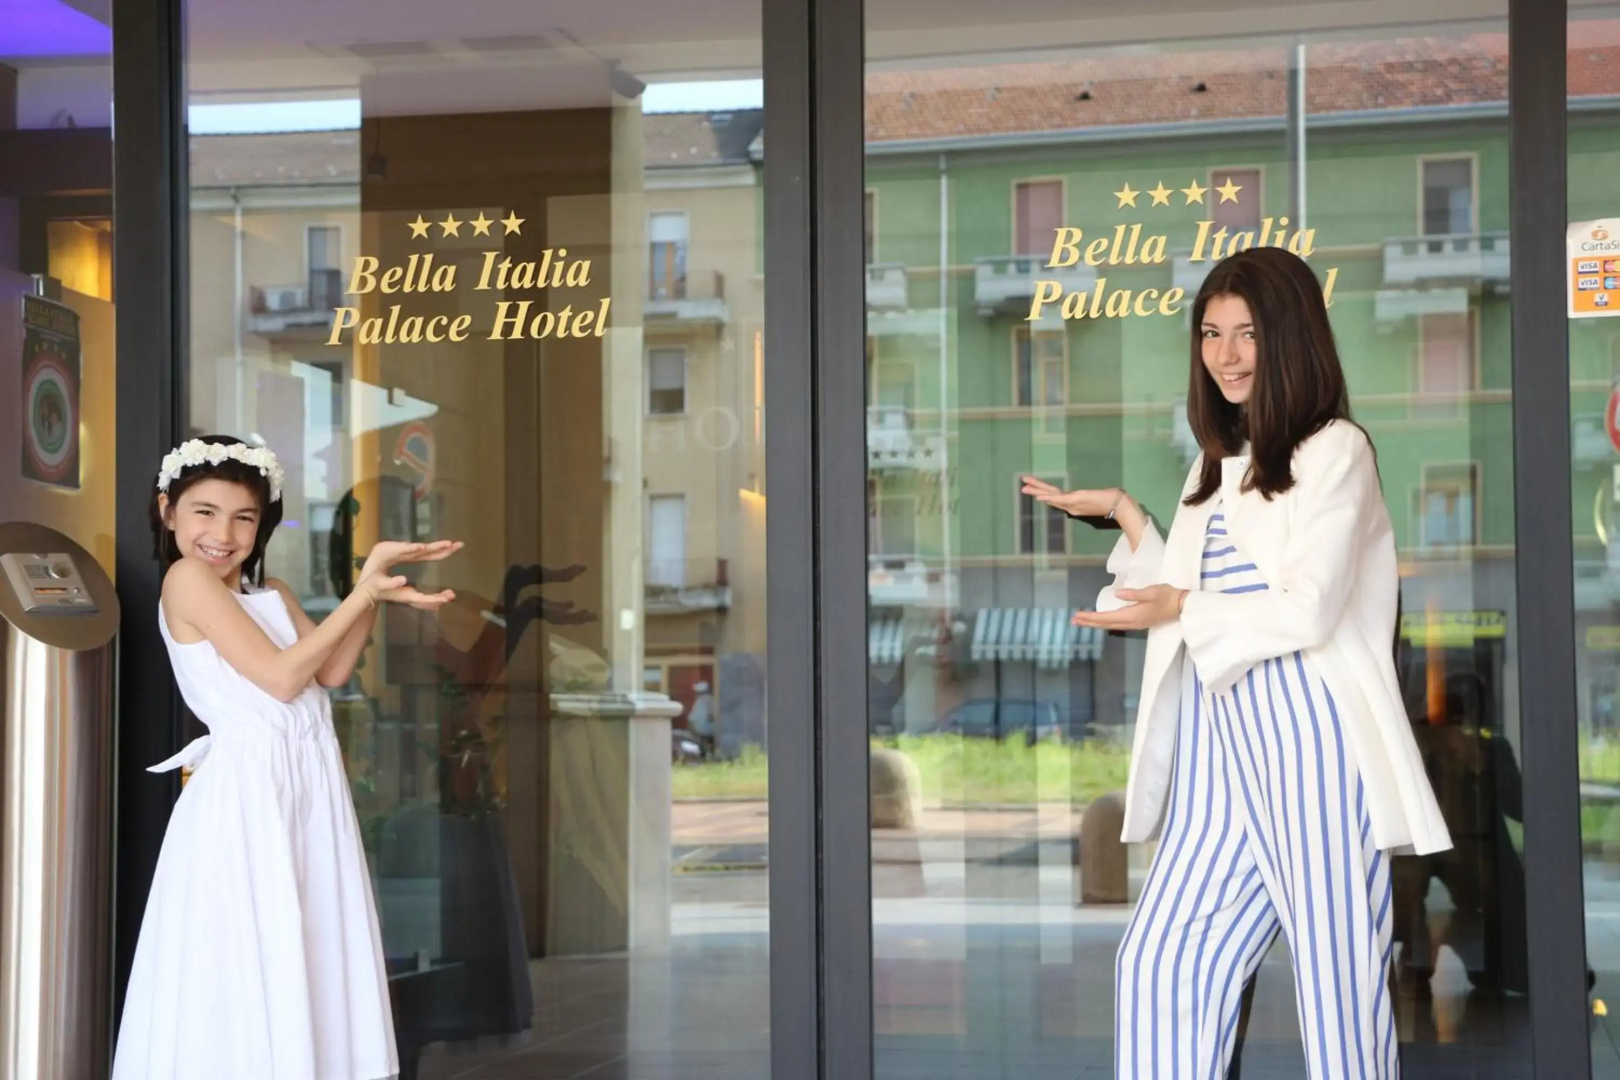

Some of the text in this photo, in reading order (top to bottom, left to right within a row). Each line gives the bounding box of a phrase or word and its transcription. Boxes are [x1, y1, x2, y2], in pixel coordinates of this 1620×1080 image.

[1044, 223, 1168, 268] Bella
[1580, 262, 1598, 270] VISA
[346, 248, 592, 295] Bella Italia
[324, 297, 611, 345] Palace Hotel
[1024, 278, 1185, 320] Palace
